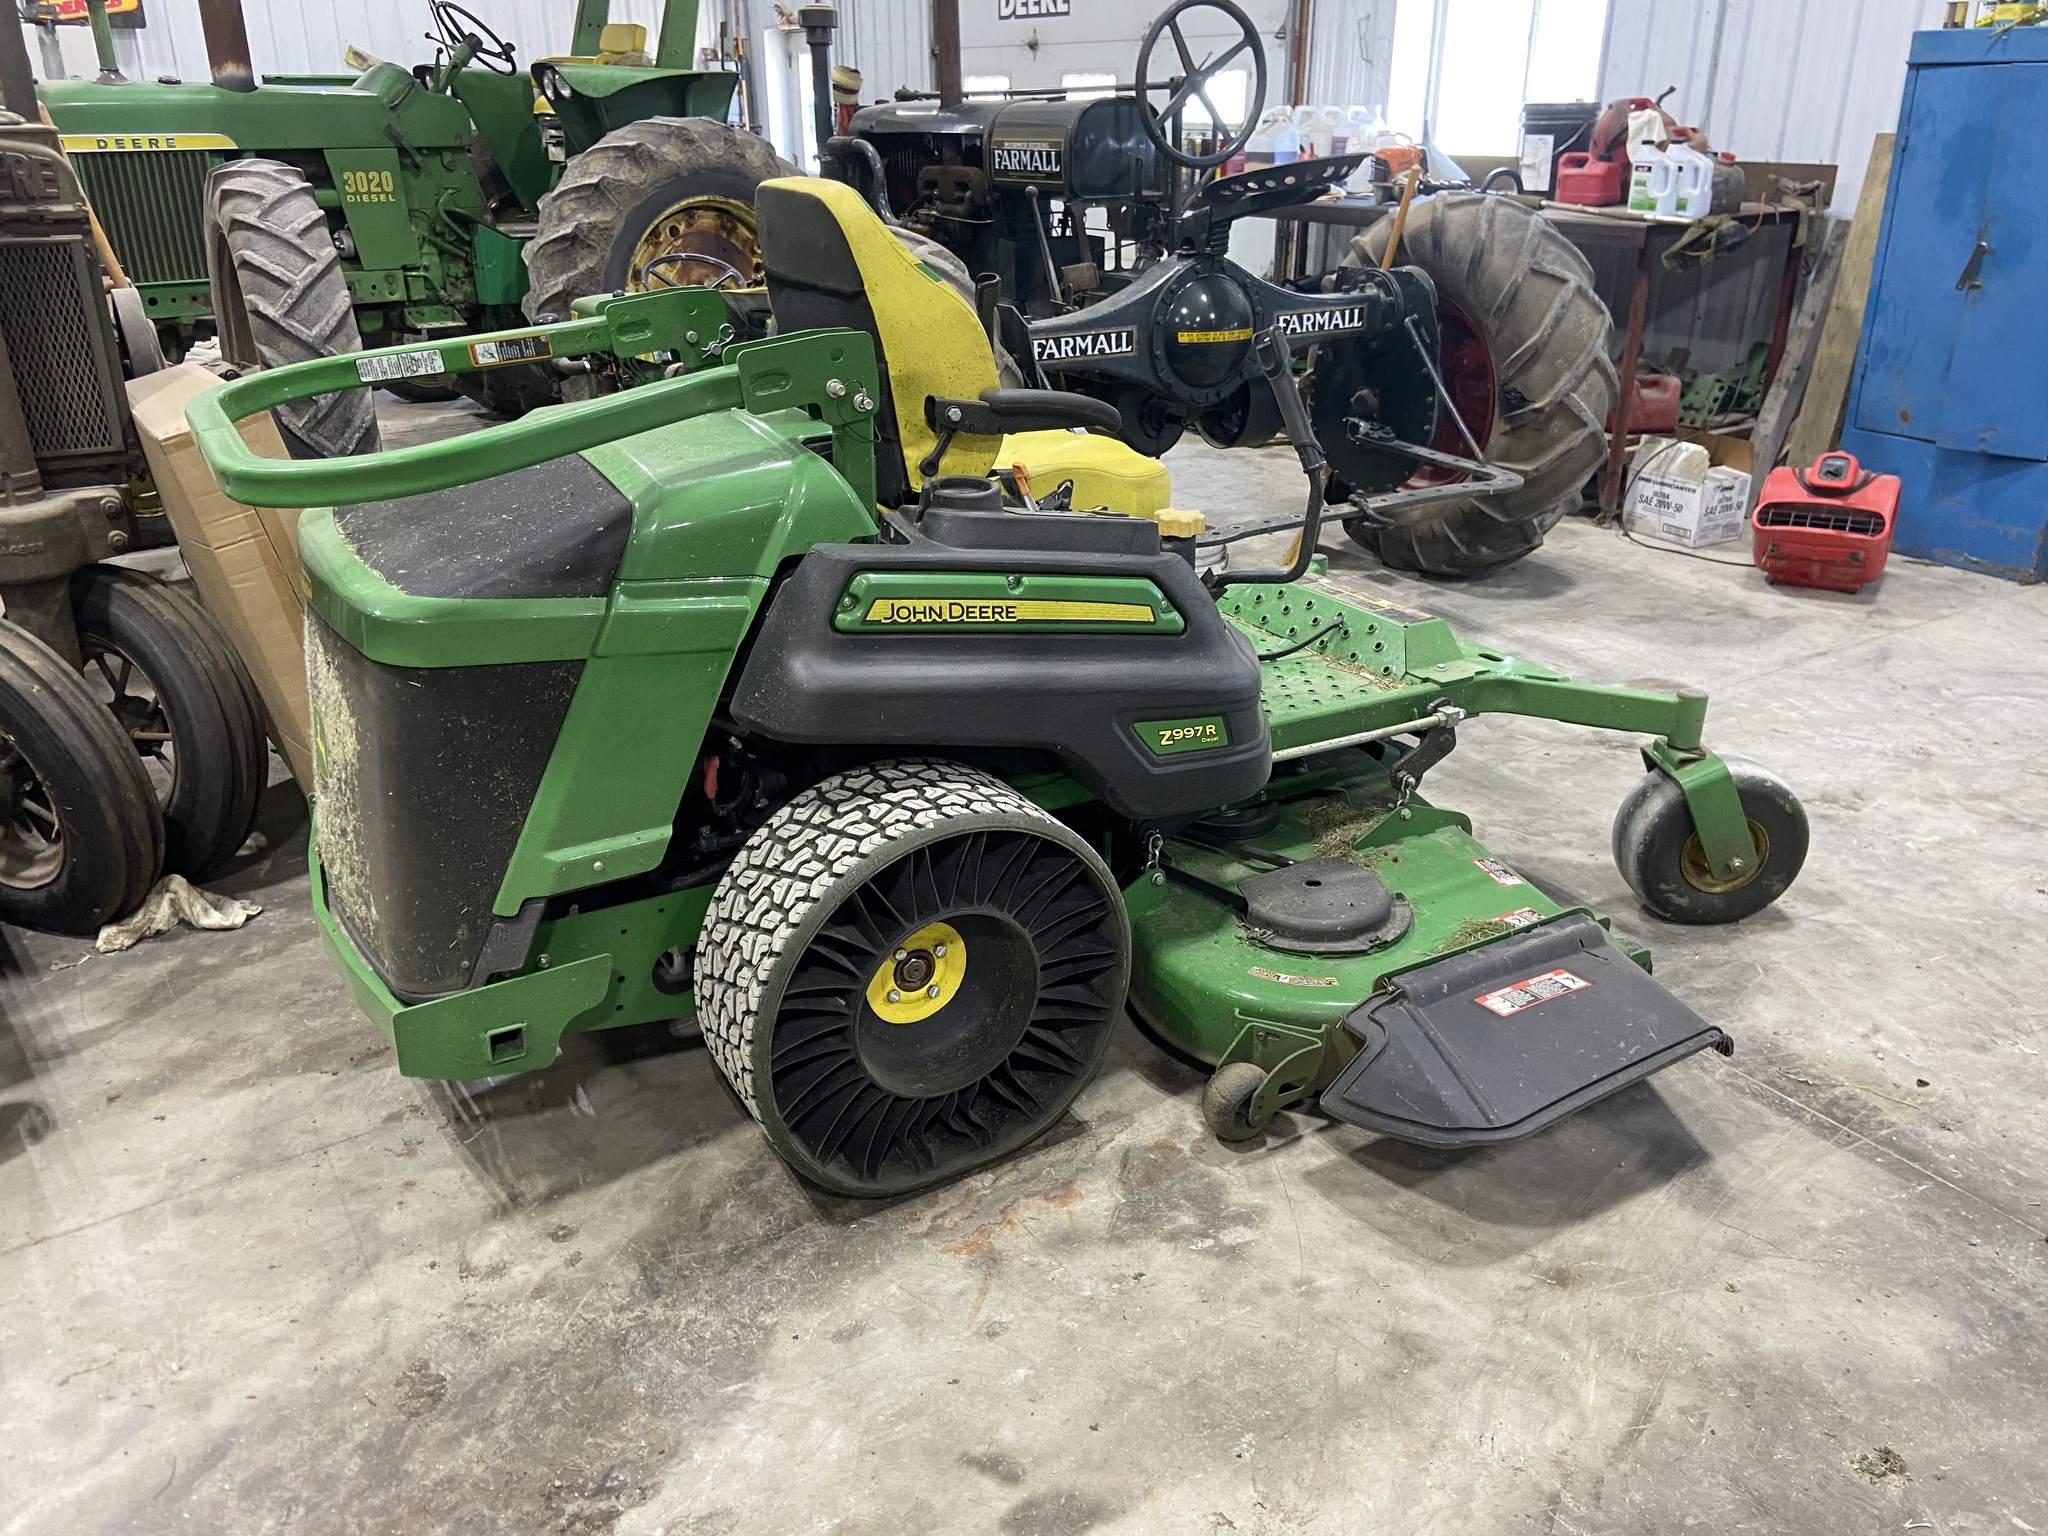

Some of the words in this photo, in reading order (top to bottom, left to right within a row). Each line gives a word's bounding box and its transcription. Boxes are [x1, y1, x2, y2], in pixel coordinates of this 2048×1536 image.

[96, 137, 177, 149] DEERE
[994, 149, 1061, 172] FARMALL
[343, 171, 394, 193] 3020
[346, 194, 396, 203] DIESEL
[1278, 308, 1363, 335] FARMALL
[1032, 332, 1133, 360] FARMALL
[1638, 494, 1655, 506] SAE
[1654, 498, 1684, 514] 20W-50
[1652, 490, 1670, 500] ULTRA
[883, 602, 943, 620] JOHN
[948, 601, 1018, 619] DEERE
